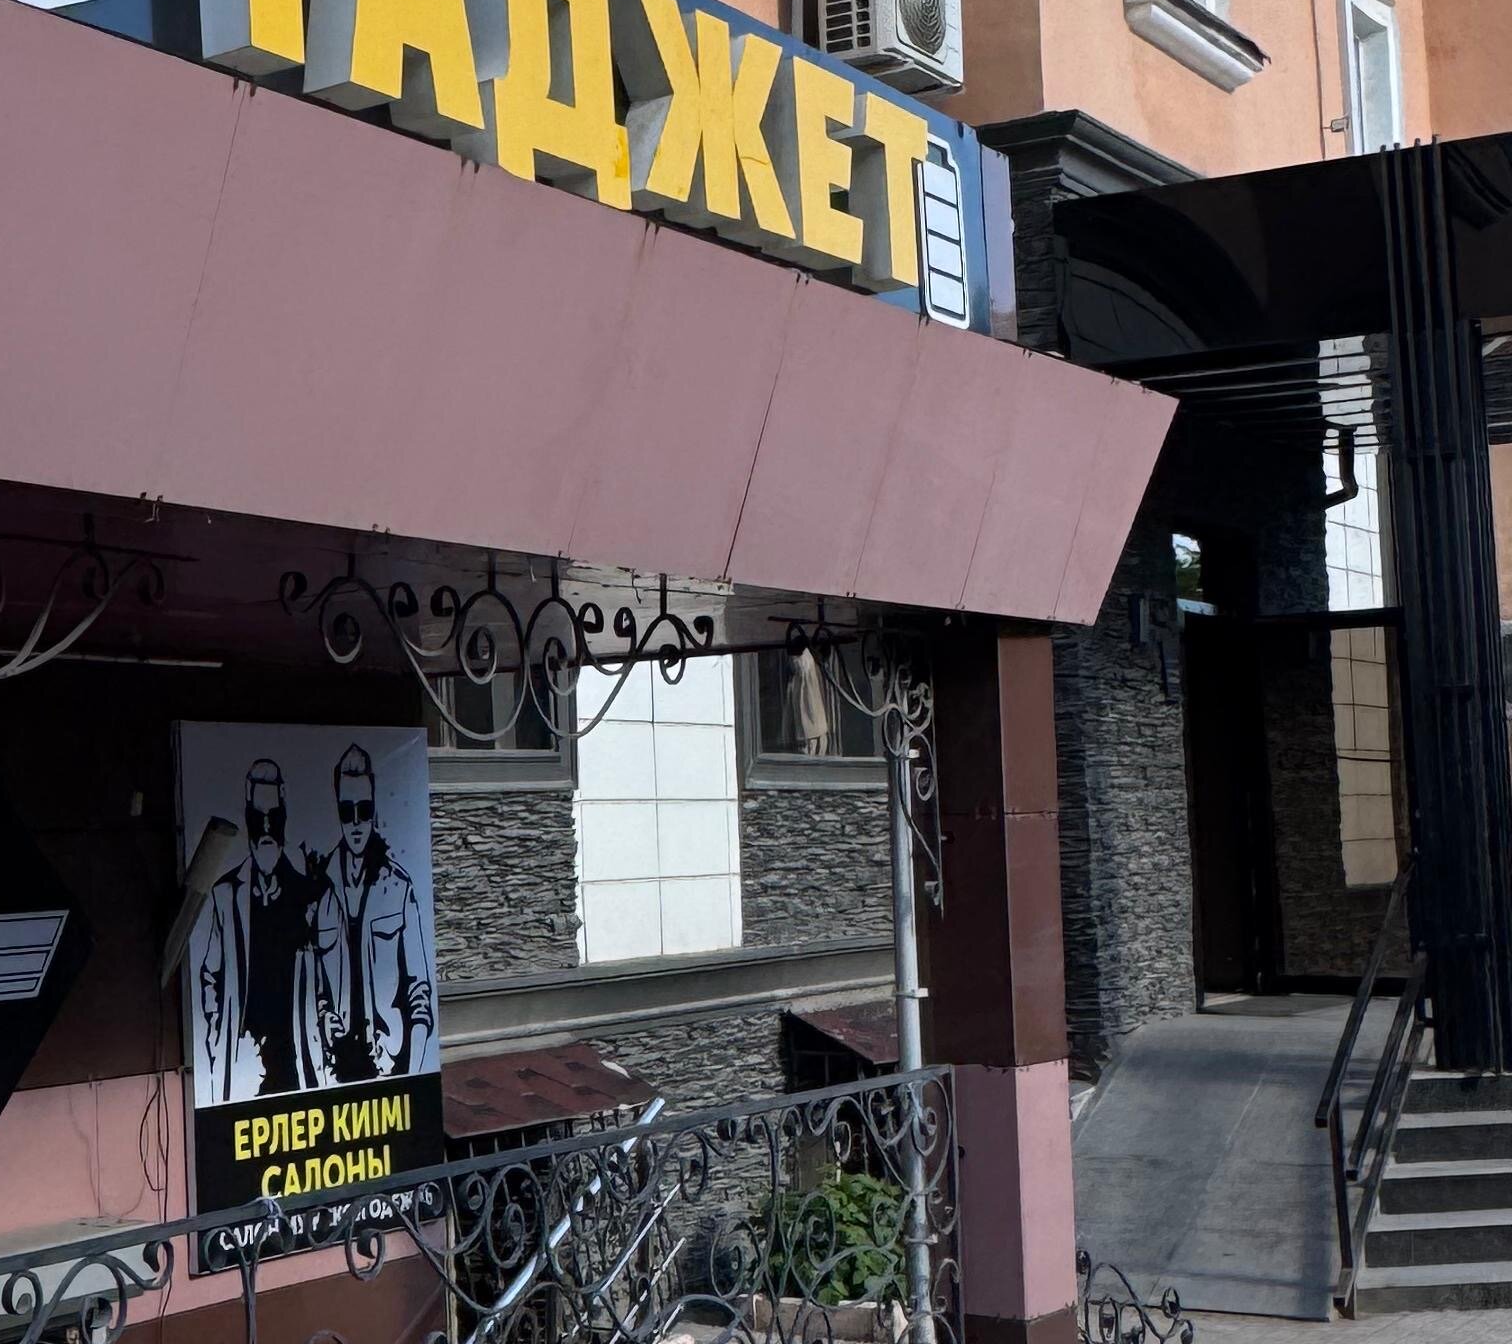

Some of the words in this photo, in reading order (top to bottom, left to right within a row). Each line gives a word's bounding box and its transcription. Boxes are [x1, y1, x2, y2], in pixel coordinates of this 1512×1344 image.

[234, 1108, 325, 1161] ЕРЛЕР
[332, 1093, 412, 1143] КИІМІ
[261, 1144, 392, 1198] САЛОНЫ
